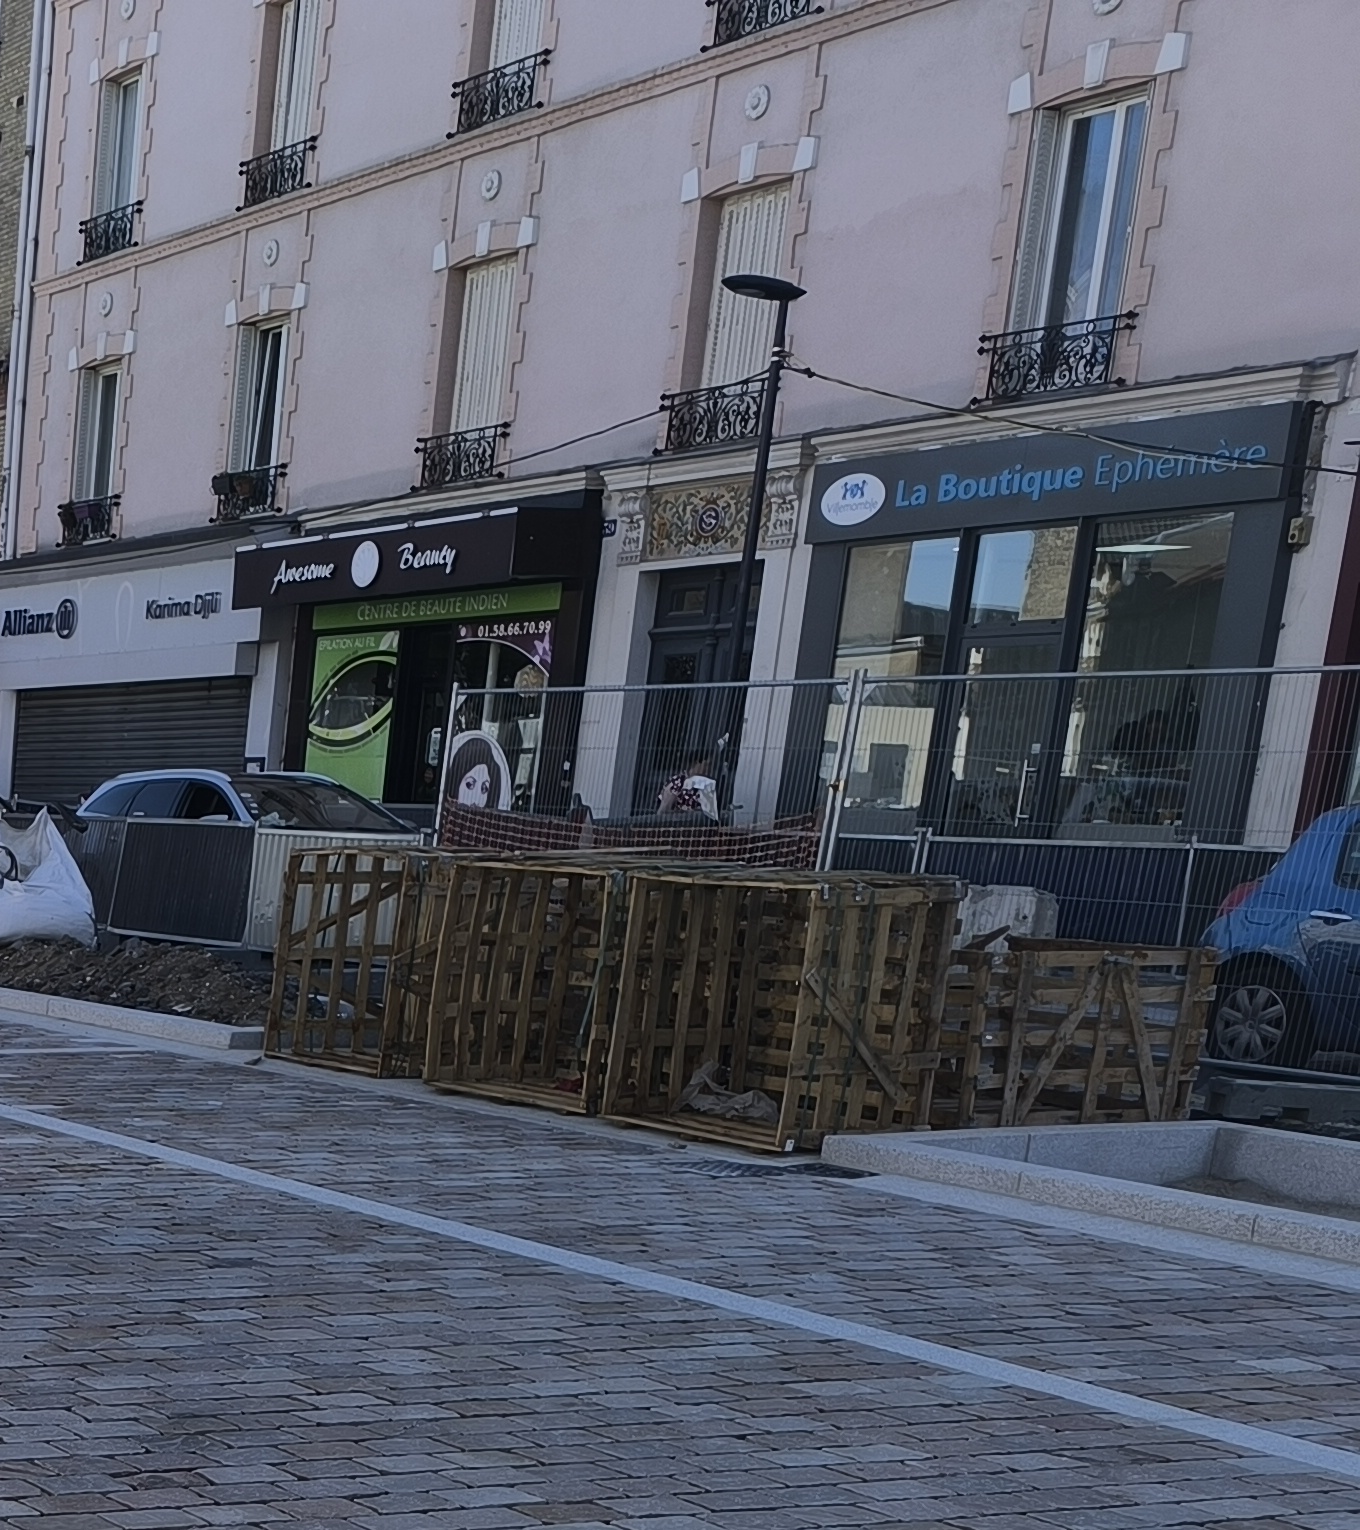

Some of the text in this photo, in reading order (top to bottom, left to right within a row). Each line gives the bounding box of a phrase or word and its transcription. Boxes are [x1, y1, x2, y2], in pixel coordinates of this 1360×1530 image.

[895, 480, 927, 507] La
[938, 463, 1083, 502] Boutique
[270, 542, 456, 595] Awesome Beauty
[357, 593, 509, 621] CENTRE DE BEAUTE INDIEN
[1, 608, 56, 637] Allianz
[477, 620, 552, 638] 01.58.66.70.99
